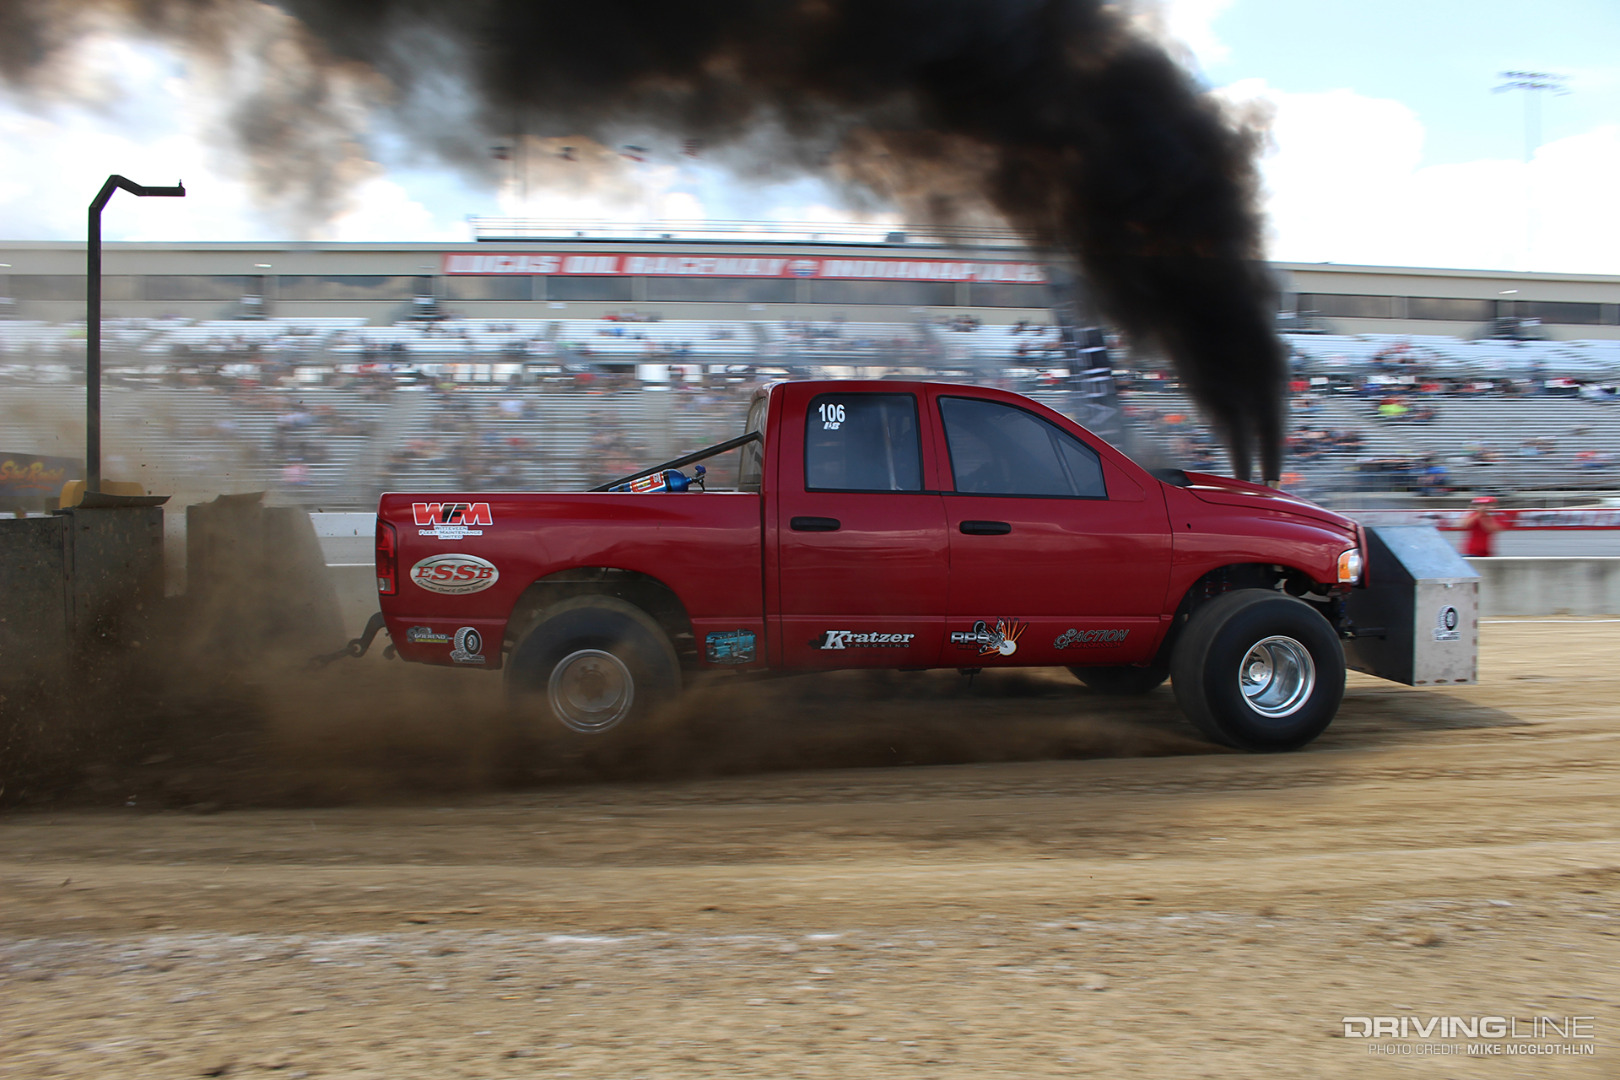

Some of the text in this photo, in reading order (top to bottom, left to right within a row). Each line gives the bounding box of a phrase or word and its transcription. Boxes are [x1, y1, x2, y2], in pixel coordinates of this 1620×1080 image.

[818, 403, 846, 423] 106
[415, 564, 494, 581] ESSB
[820, 630, 915, 650] Kratzer
[950, 631, 989, 644] RPS
[1070, 629, 1130, 643] ACTION
